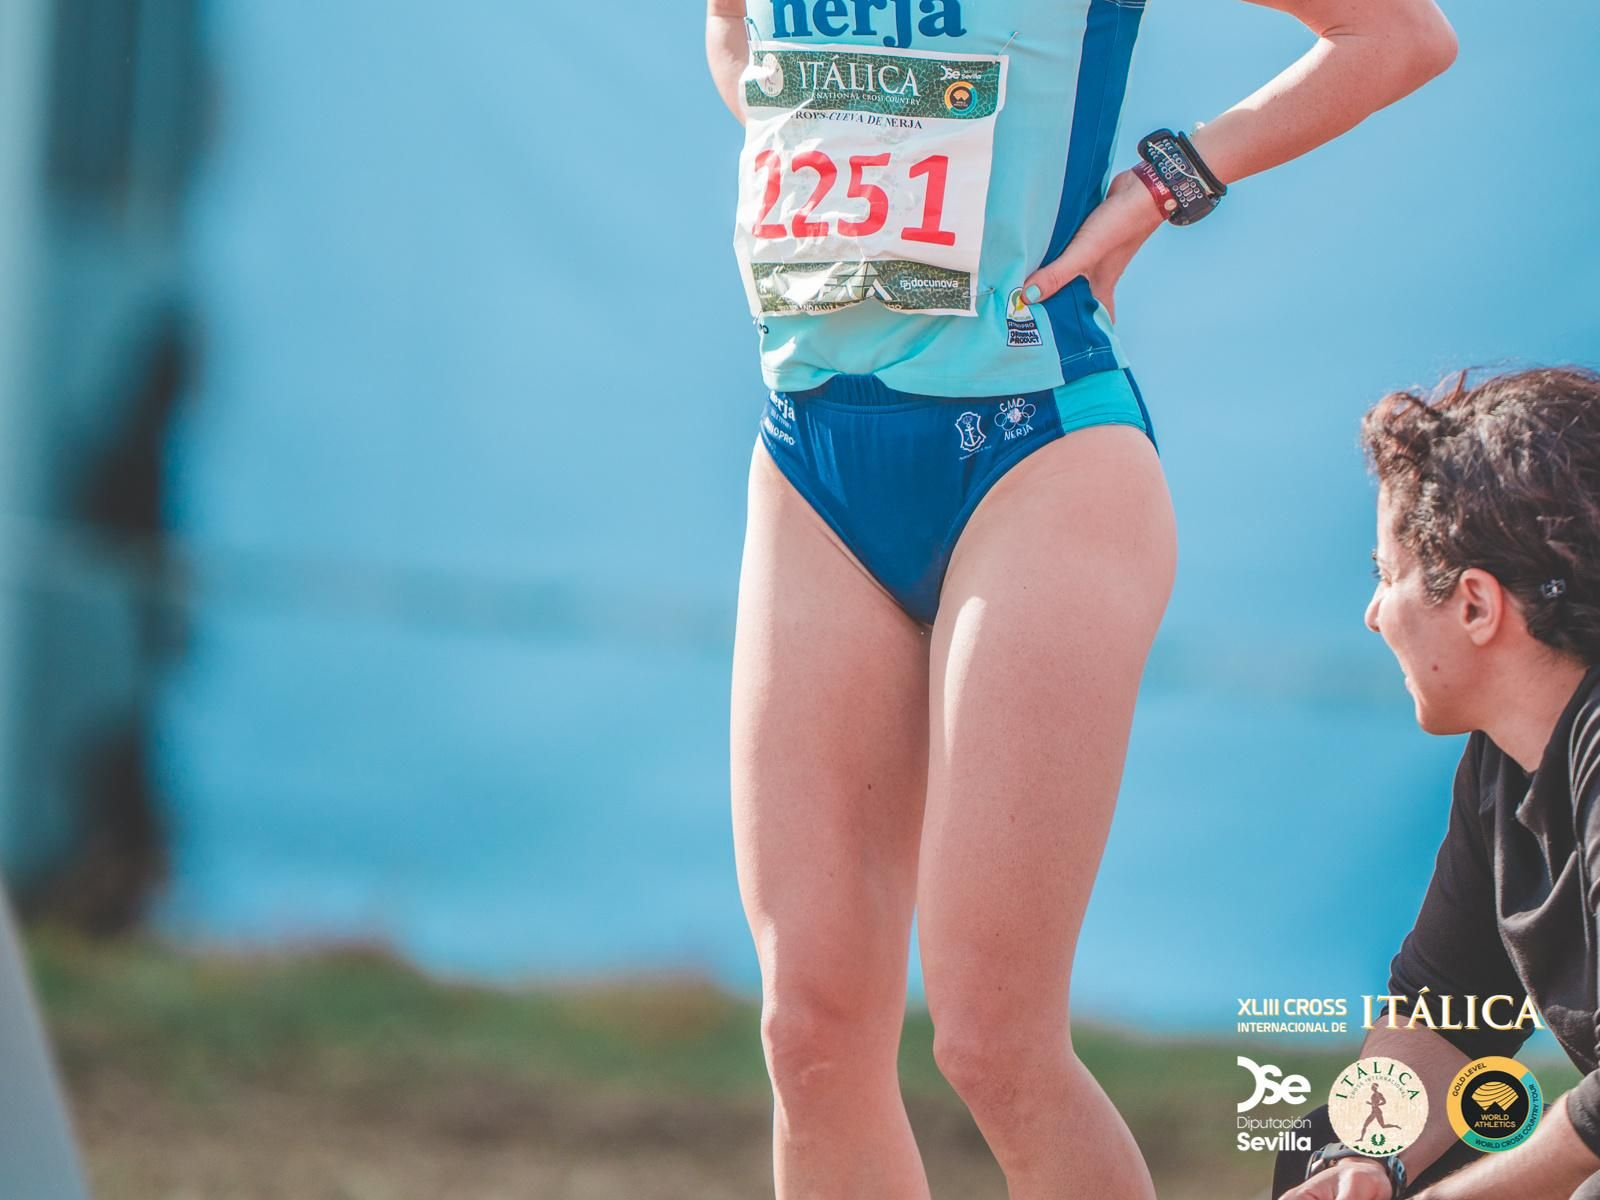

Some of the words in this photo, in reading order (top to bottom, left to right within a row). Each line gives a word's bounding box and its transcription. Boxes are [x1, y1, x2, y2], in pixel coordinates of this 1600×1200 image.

[798, 54, 922, 97] ITÁLICA
[867, 115, 881, 127] DE
[752, 149, 956, 246] 2251
[910, 278, 959, 289] docunova
[1000, 398, 1026, 412] CMD
[1004, 424, 1034, 441] NERJA
